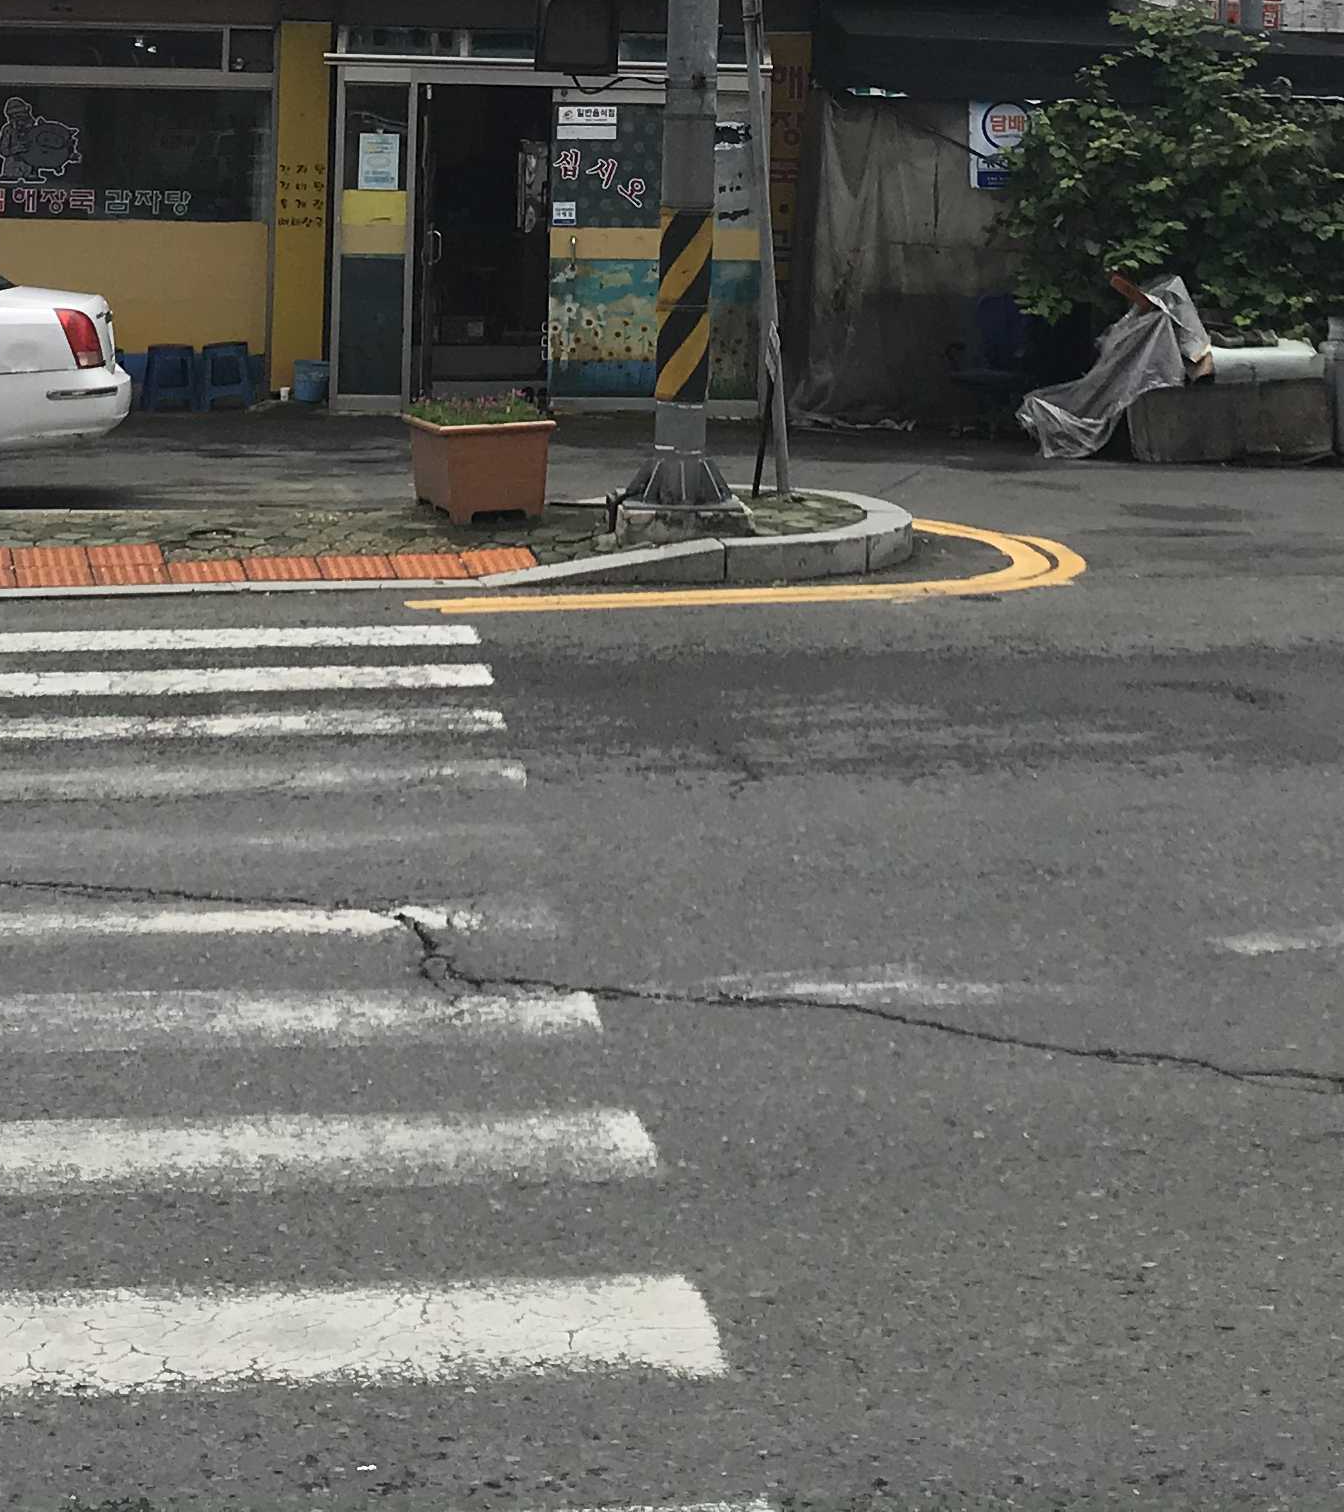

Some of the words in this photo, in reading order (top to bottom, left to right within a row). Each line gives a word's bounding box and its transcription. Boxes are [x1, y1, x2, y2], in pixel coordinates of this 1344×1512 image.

[990, 114, 1025, 133] 담배
[11, 187, 97, 216] 해장국
[104, 189, 192, 216] 감자탕
